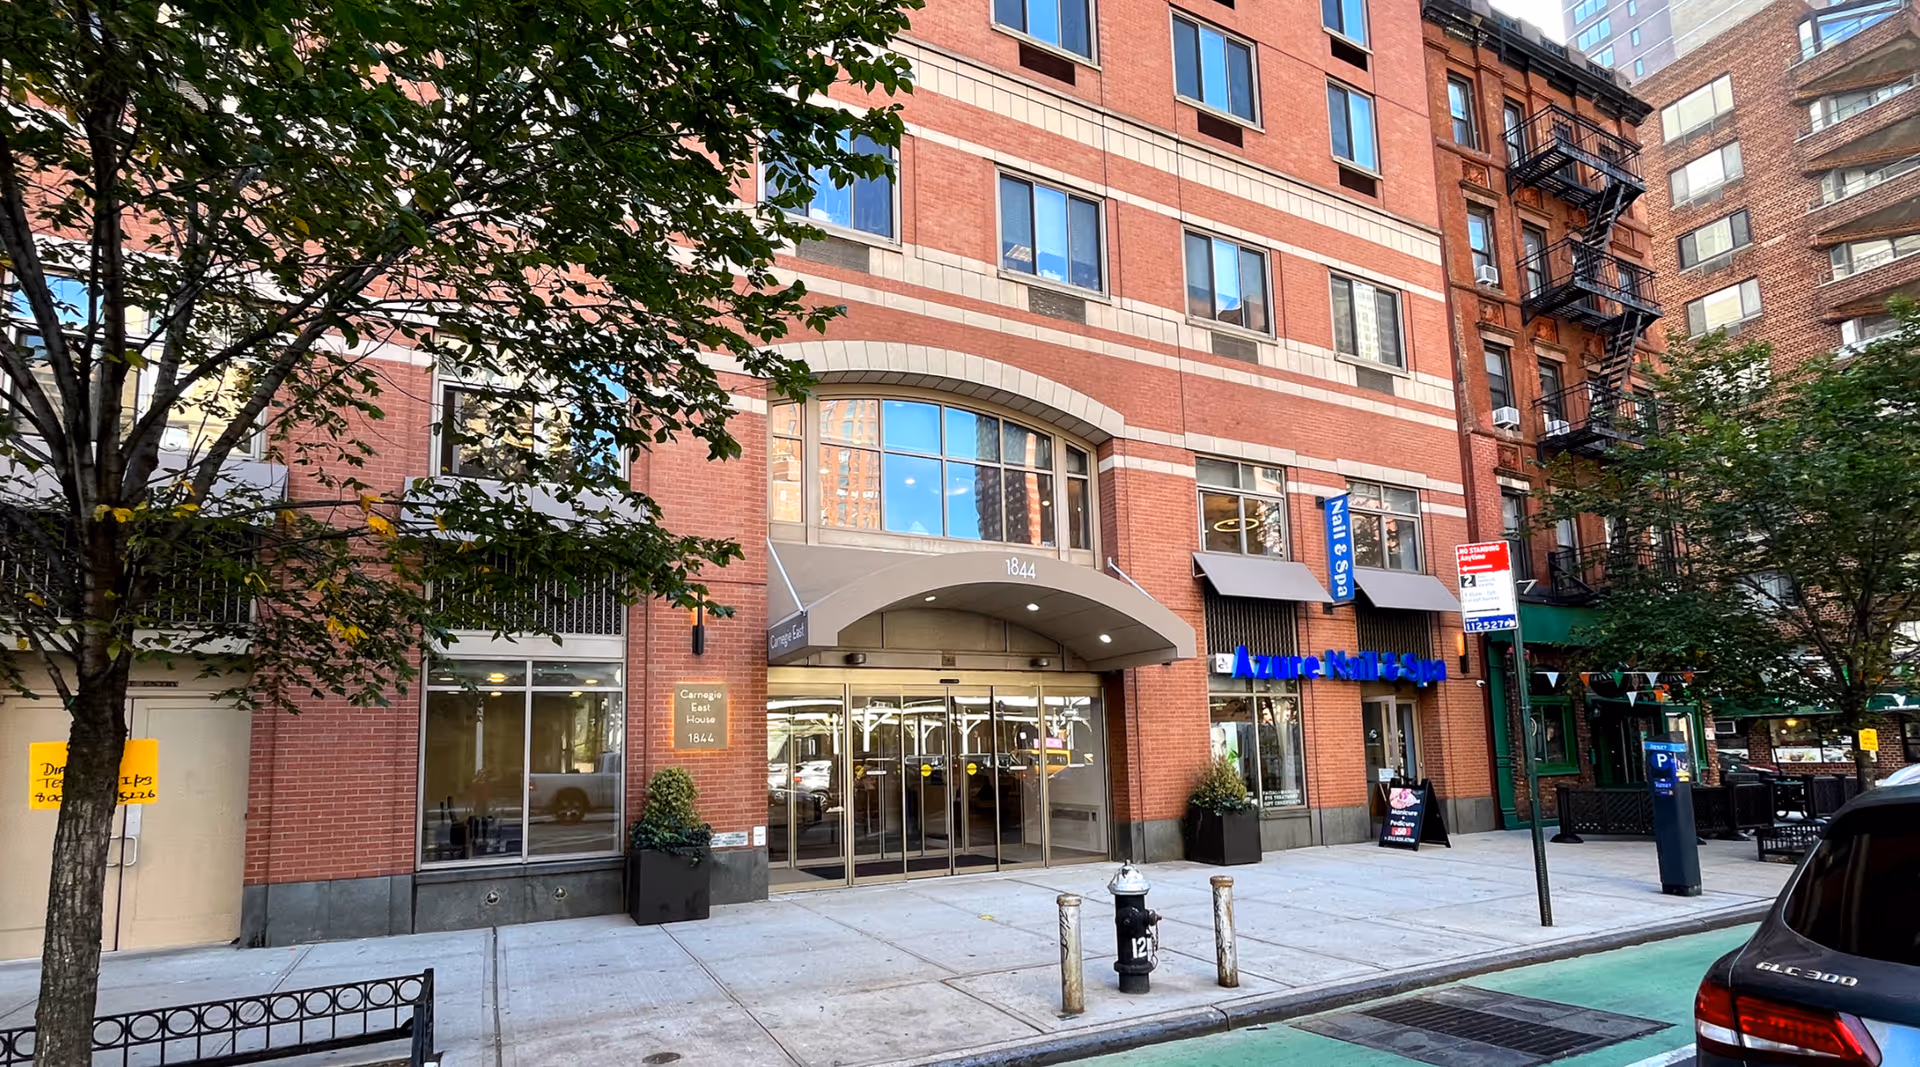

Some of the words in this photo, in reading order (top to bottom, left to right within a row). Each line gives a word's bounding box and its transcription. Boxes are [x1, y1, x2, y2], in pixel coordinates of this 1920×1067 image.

[1331, 499, 1346, 540] Nail
[1334, 543, 1347, 556] &
[1469, 545, 1500, 554] STANDING
[1460, 554, 1486, 562] Anytime
[1005, 557, 1036, 579] 1844
[1334, 559, 1348, 597] Spa
[1463, 575, 1474, 587] 2
[770, 629, 792, 649] Carnegie
[792, 622, 805, 640] East
[1232, 645, 1320, 680] Azure
[1325, 649, 1379, 680] Nail
[1381, 651, 1400, 681] &
[1400, 652, 1447, 687] Spa
[680, 690, 722, 701] Carnegie
[691, 702, 711, 712] East
[686, 714, 716, 724] House
[688, 733, 715, 744] 1844
[1656, 753, 1668, 767] P
[1390, 808, 1418, 816] Manicure
[1389, 819, 1415, 828] Pedicure
[1756, 961, 1801, 976] GLC
[1804, 969, 1859, 987] 300
